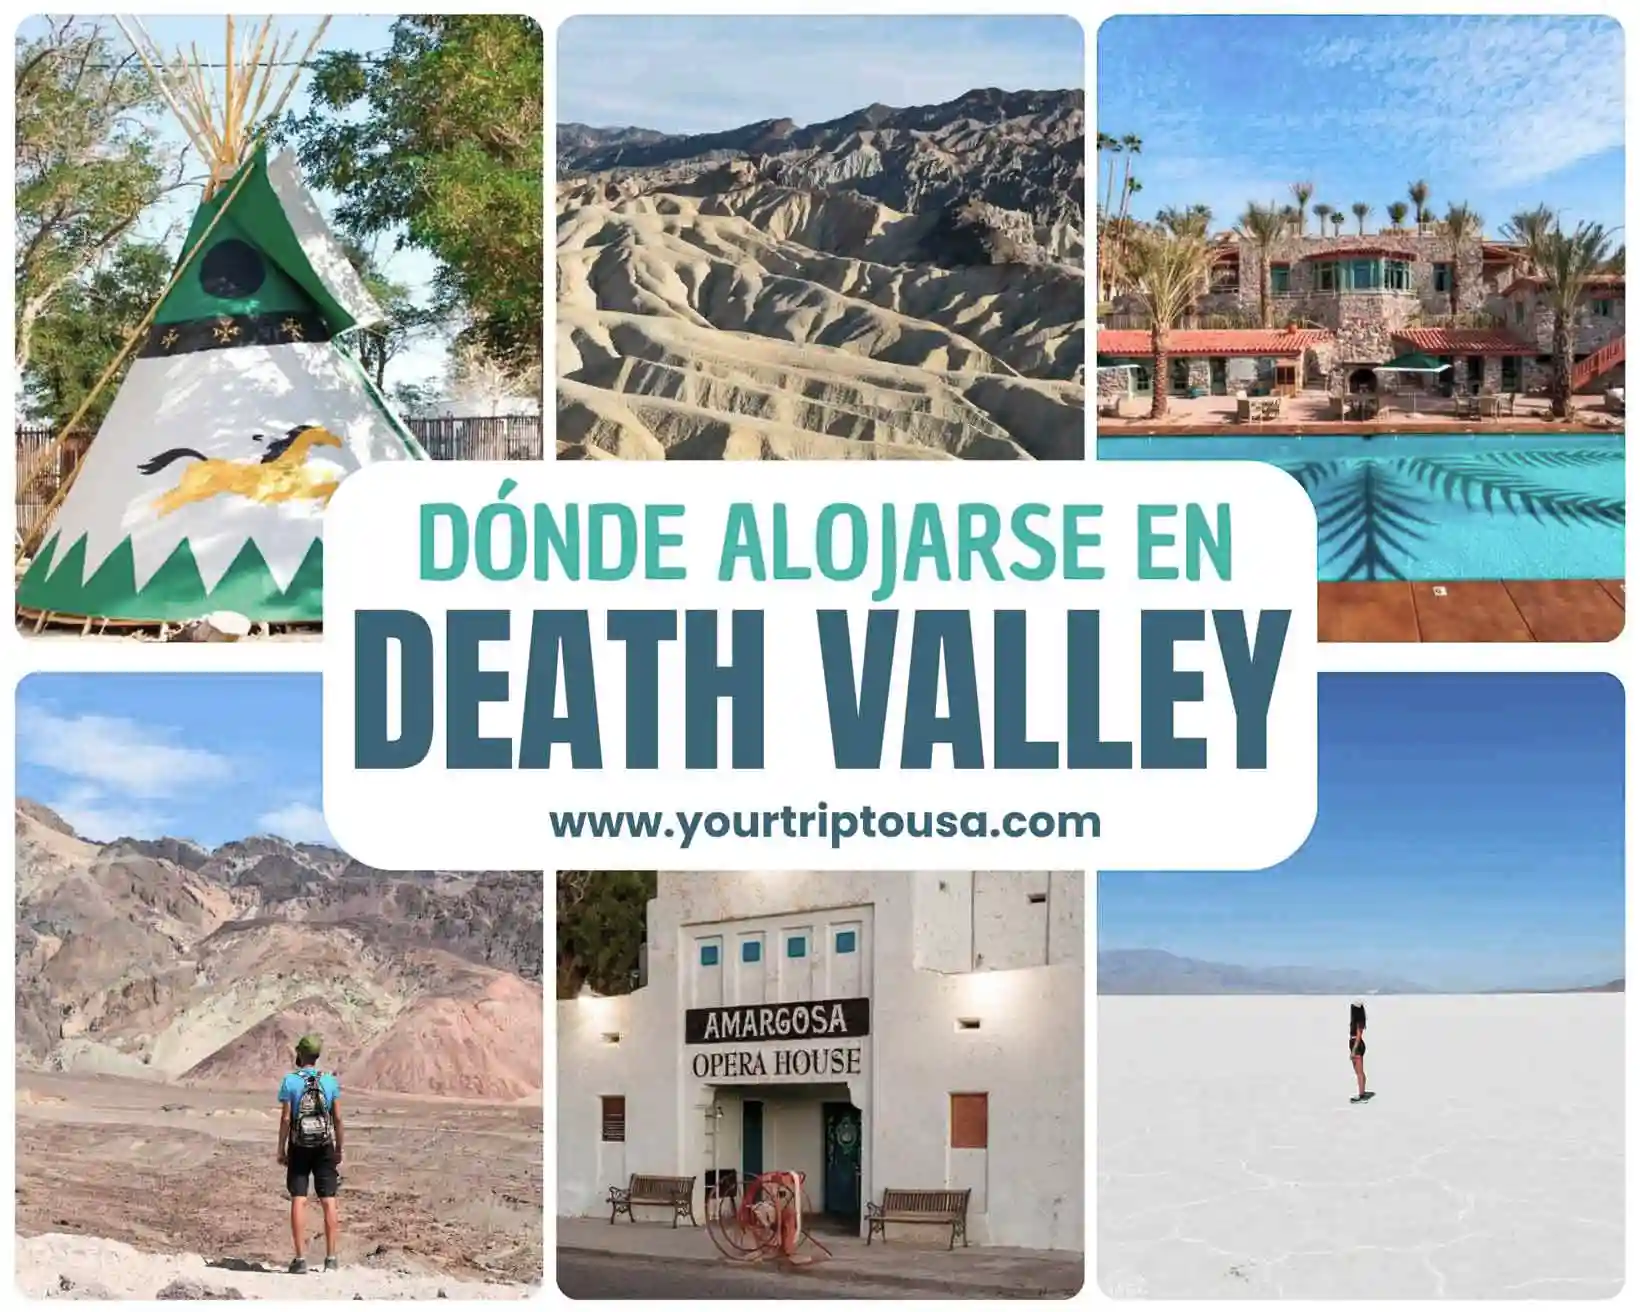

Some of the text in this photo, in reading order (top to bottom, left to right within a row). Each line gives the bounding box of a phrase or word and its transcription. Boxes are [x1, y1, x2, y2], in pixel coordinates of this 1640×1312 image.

[703, 1003, 848, 1040] AMARGOSA
[692, 1048, 862, 1078] OPERA HOUSE
